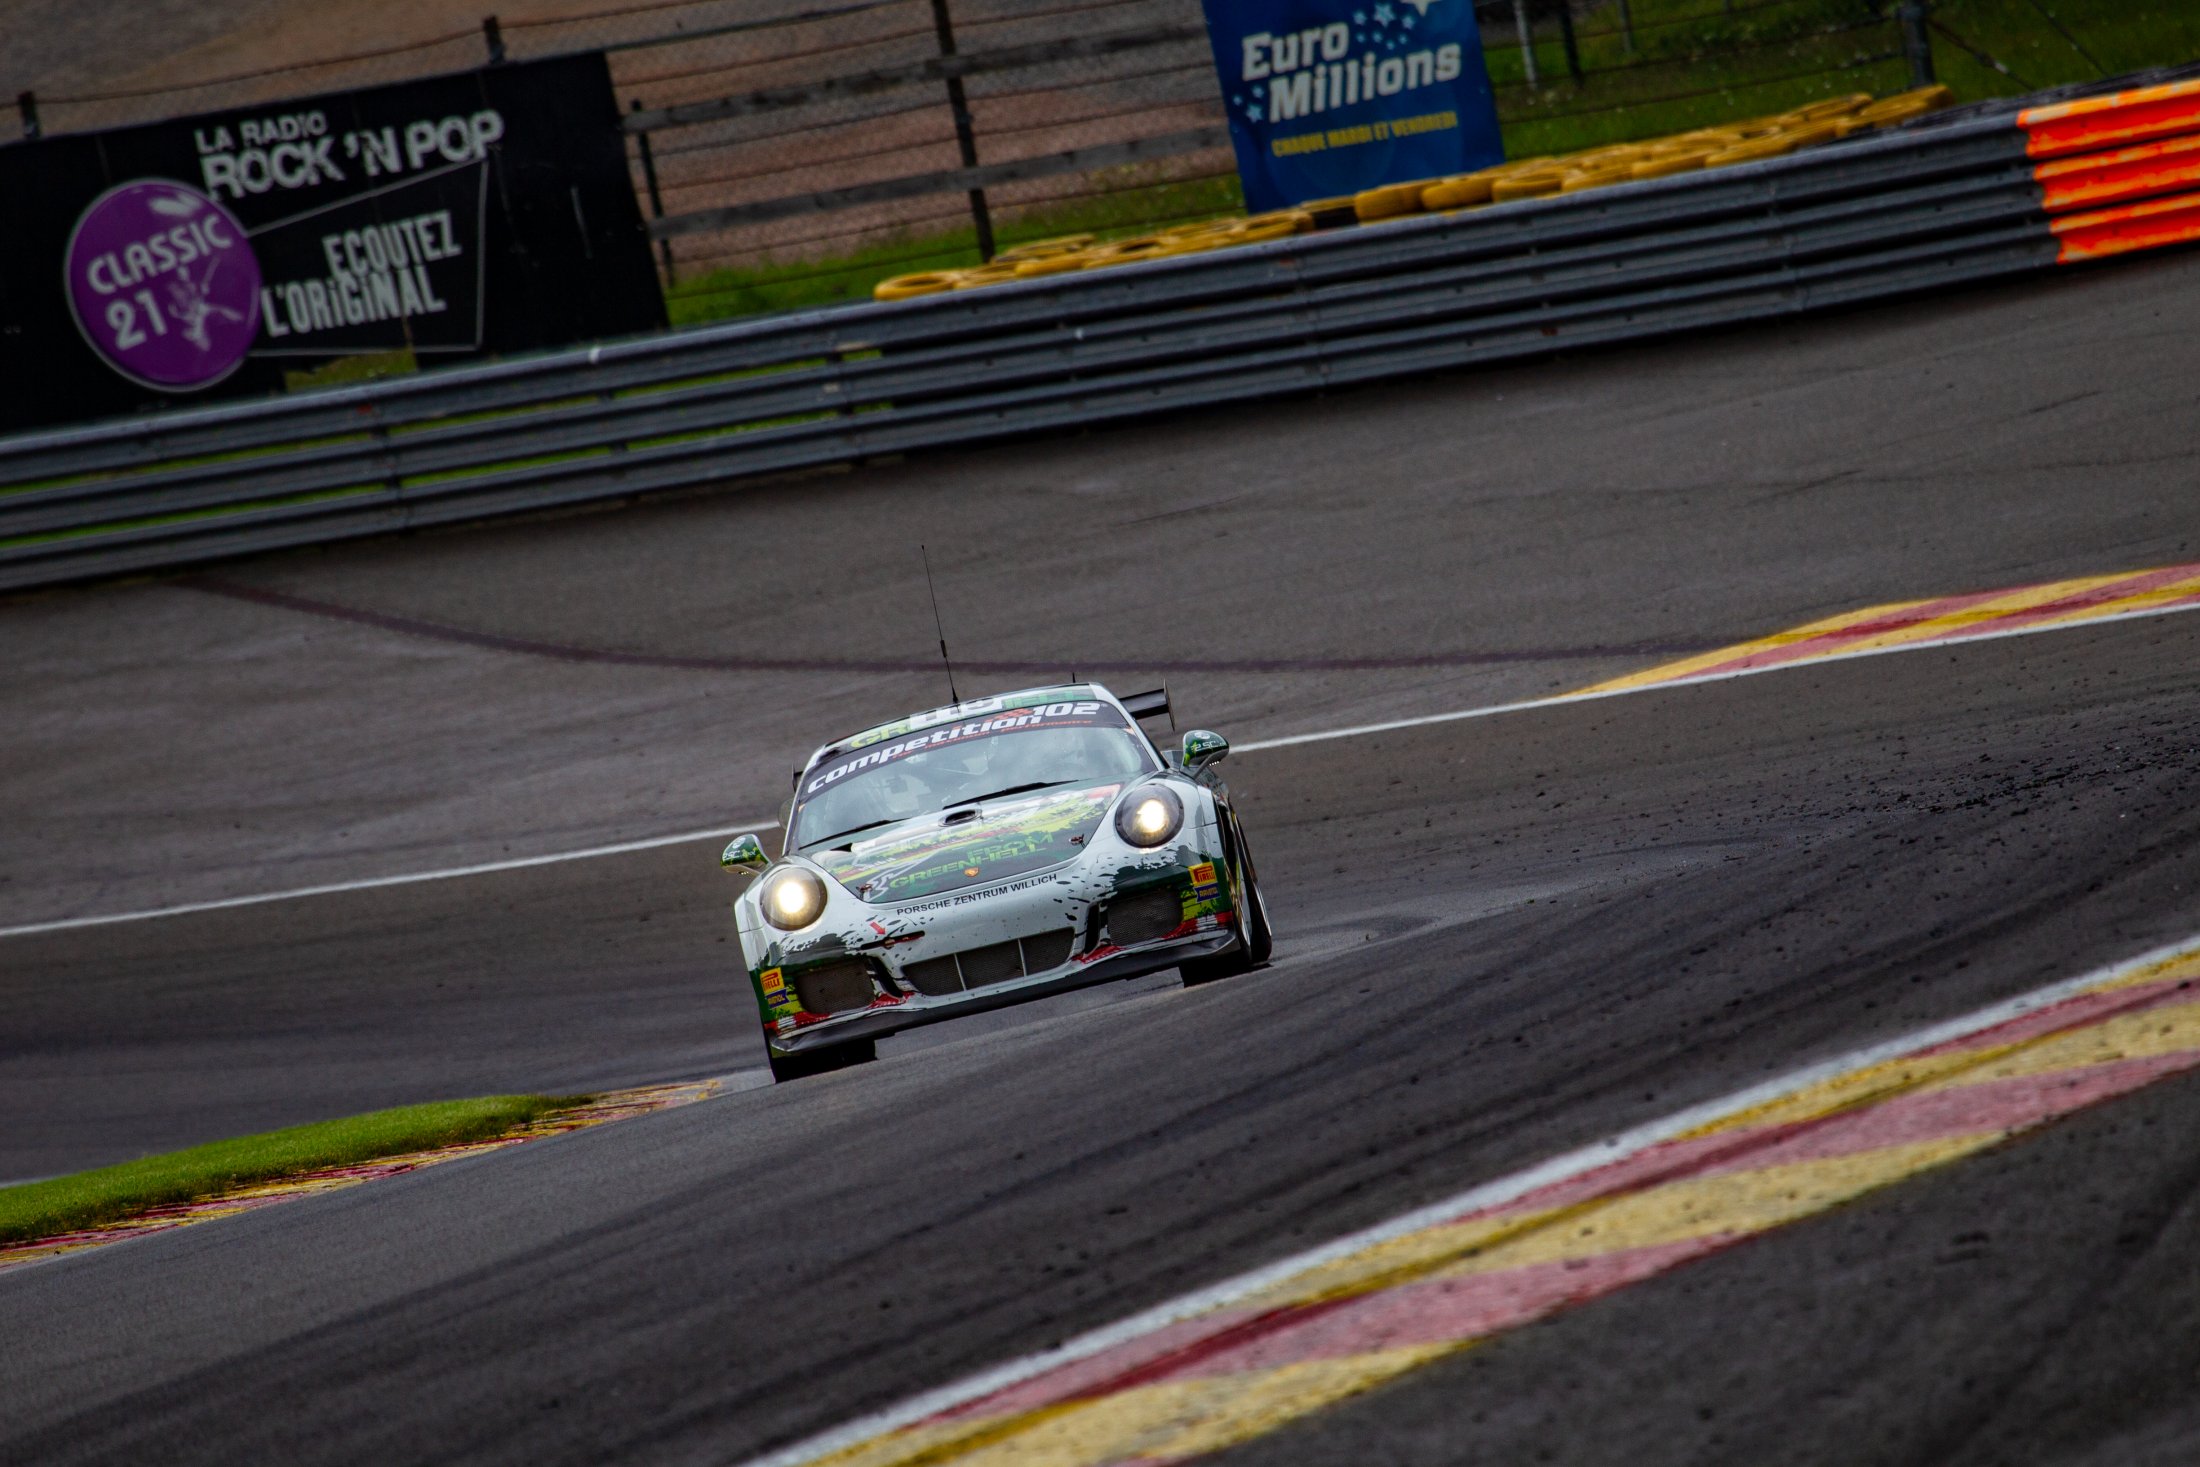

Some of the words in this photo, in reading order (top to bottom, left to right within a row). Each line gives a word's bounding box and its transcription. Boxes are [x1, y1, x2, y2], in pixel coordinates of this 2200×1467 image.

[1242, 22, 1349, 81] Euro
[1269, 43, 1462, 123] Millions
[195, 130, 234, 154] LA
[201, 139, 346, 200] ROCK
[406, 109, 504, 169] POP
[87, 214, 233, 294] CLASSIC
[323, 210, 462, 279] ECOUTEZ
[106, 290, 168, 350] 21
[966, 832, 1054, 860] FROM
[896, 899, 951, 915] PORSCHE
[954, 885, 1008, 905] ZENTRUM
[1010, 873, 1058, 892] WILLICH
